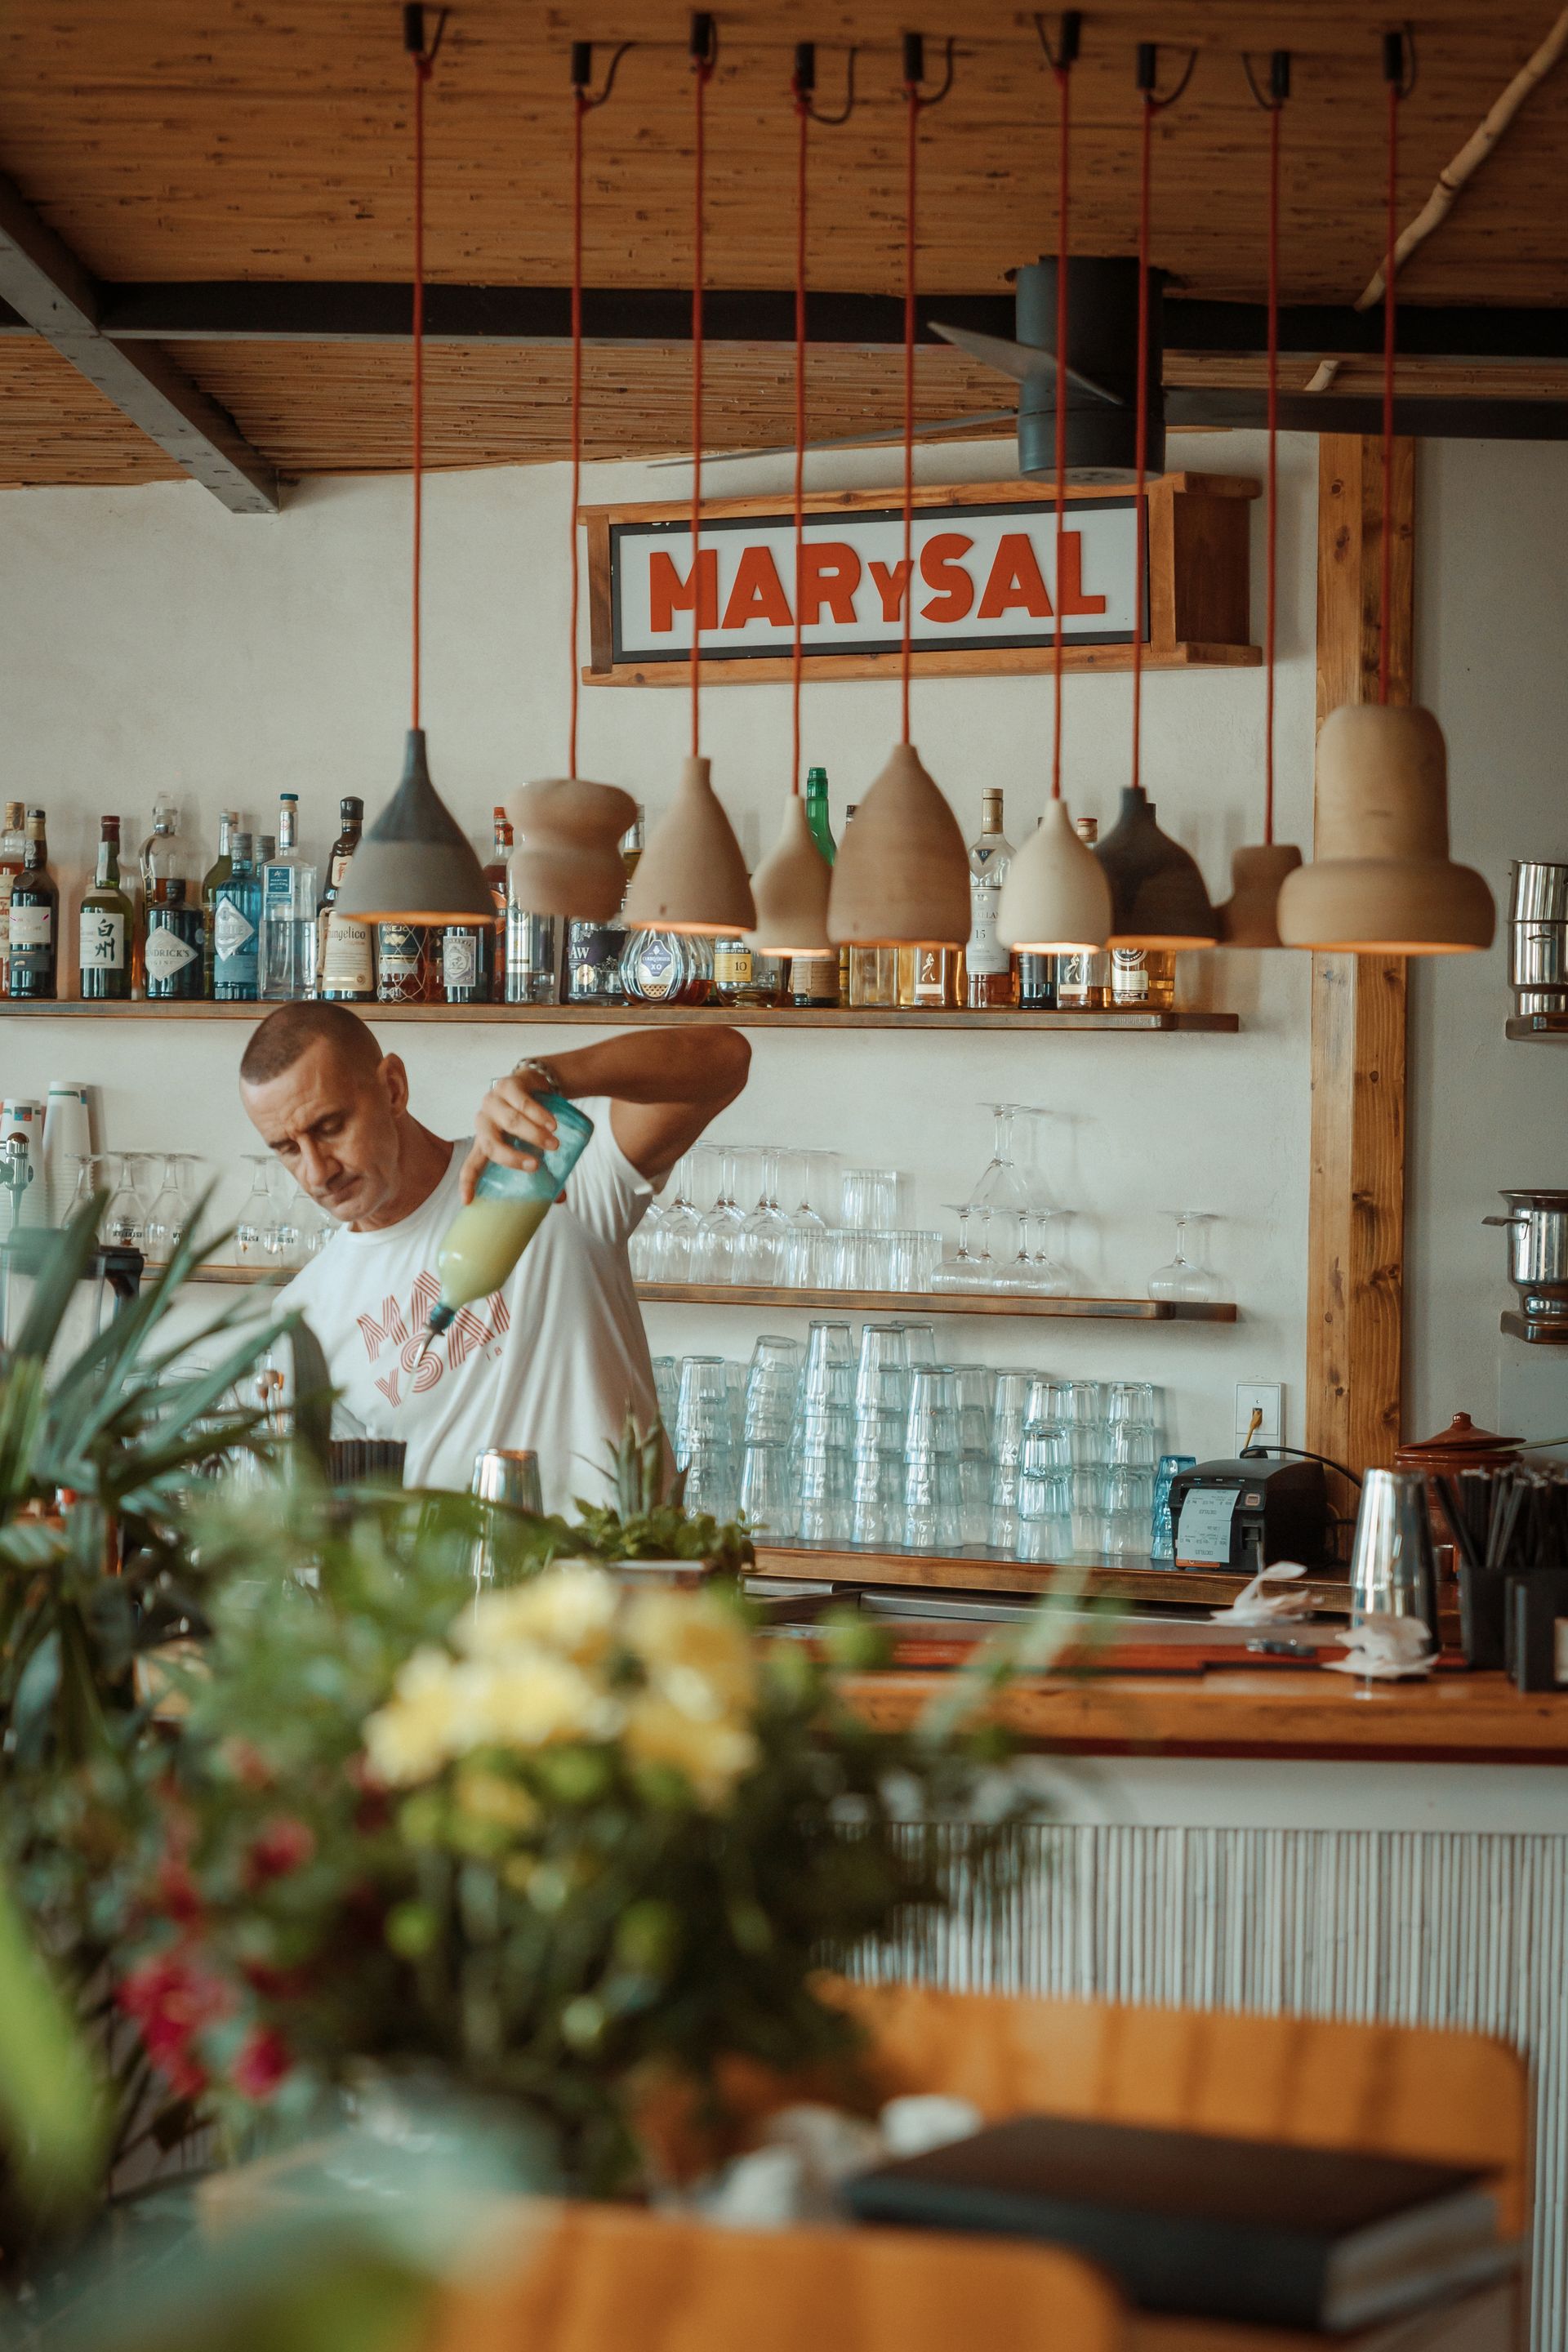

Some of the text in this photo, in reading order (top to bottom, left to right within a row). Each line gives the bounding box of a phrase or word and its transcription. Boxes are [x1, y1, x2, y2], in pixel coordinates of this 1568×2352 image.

[975, 929, 986, 938] 15
[96, 919, 114, 961] 白州
[735, 961, 747, 971] 10
